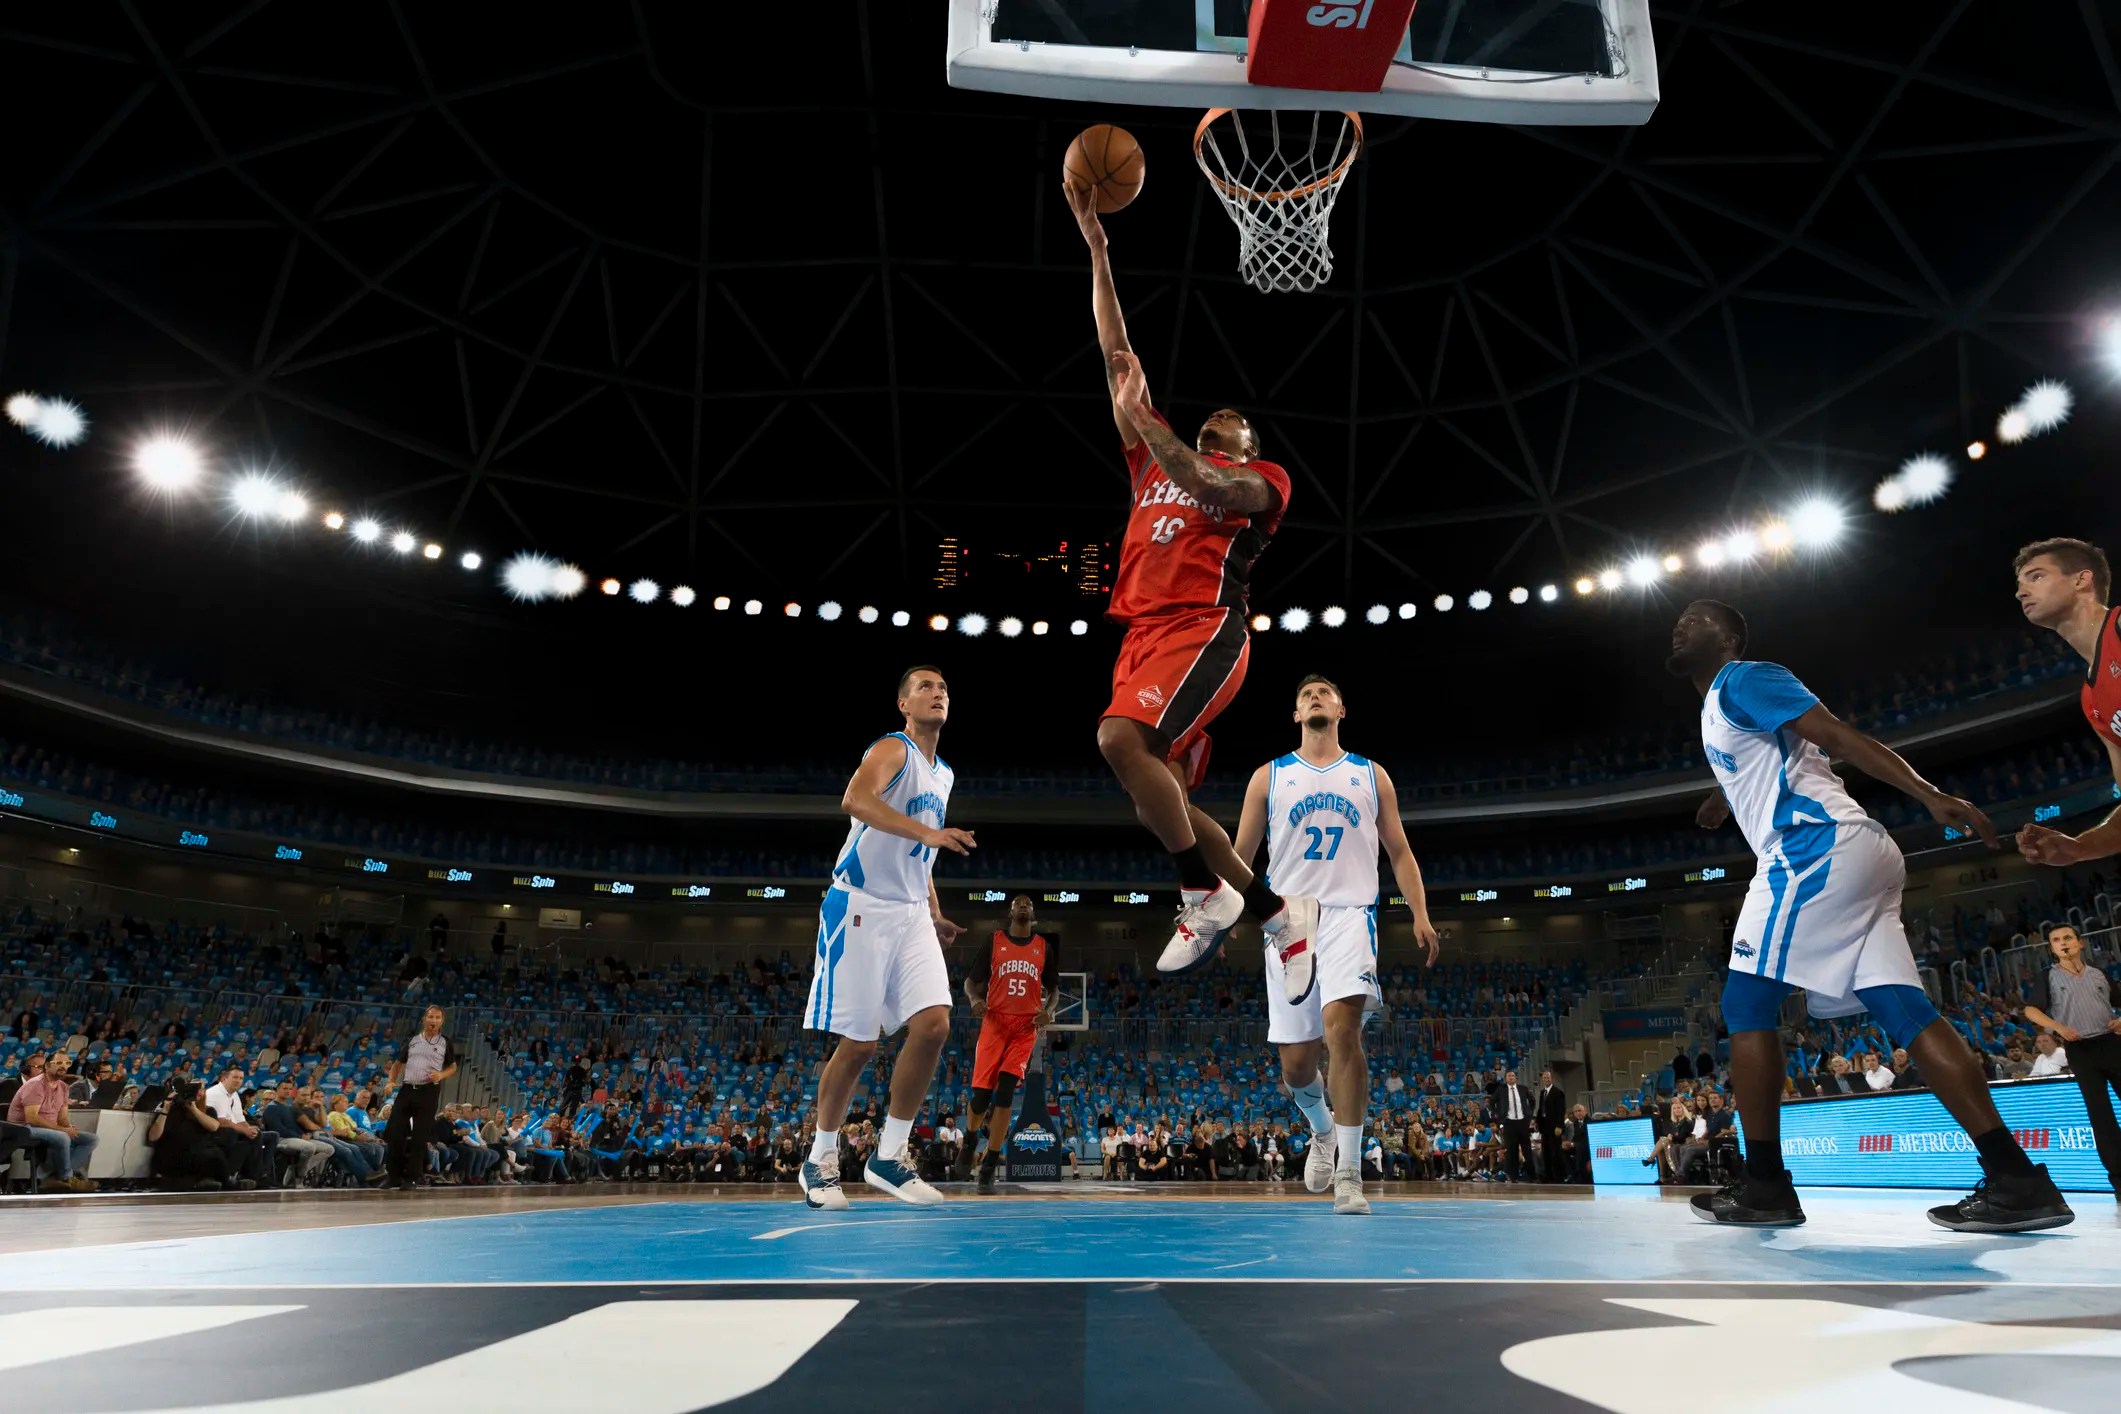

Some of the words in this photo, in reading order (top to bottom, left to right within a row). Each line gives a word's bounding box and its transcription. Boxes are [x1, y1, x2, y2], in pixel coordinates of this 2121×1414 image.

[1138, 690, 1164, 705] ICEBERGS
[1288, 791, 1361, 828] MAGNETS
[90, 811, 117, 829] Spin
[179, 830, 208, 847] Spin
[1304, 826, 1344, 860] 27
[275, 845, 302, 860] Spin
[998, 959, 1039, 982] ICEBERGS
[1008, 978, 1027, 997] 55
[1647, 1016, 1684, 1028] METRI
[1013, 1133, 1056, 1142] MAGNETS
[1781, 1136, 1838, 1155] METRICOS
[1898, 1131, 1975, 1152] METRICOS
[1012, 1164, 1056, 1177] PLAYOFFS
